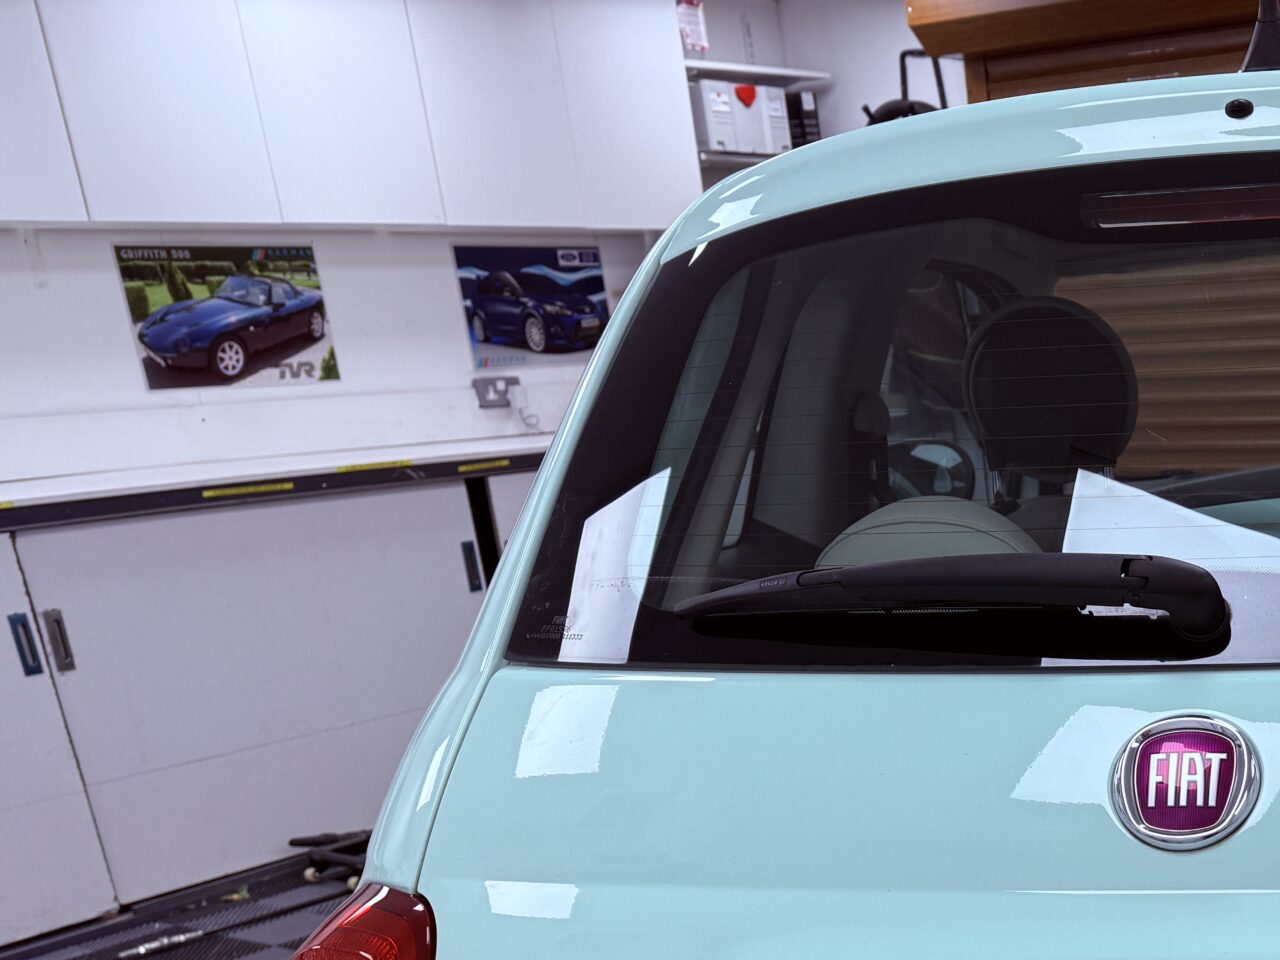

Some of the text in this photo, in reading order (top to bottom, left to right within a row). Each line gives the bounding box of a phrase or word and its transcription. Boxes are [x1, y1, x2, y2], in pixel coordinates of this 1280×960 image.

[121, 248, 167, 259] GRIFFITH
[272, 361, 315, 379] TVR
[1147, 752, 1228, 807] FIAT
